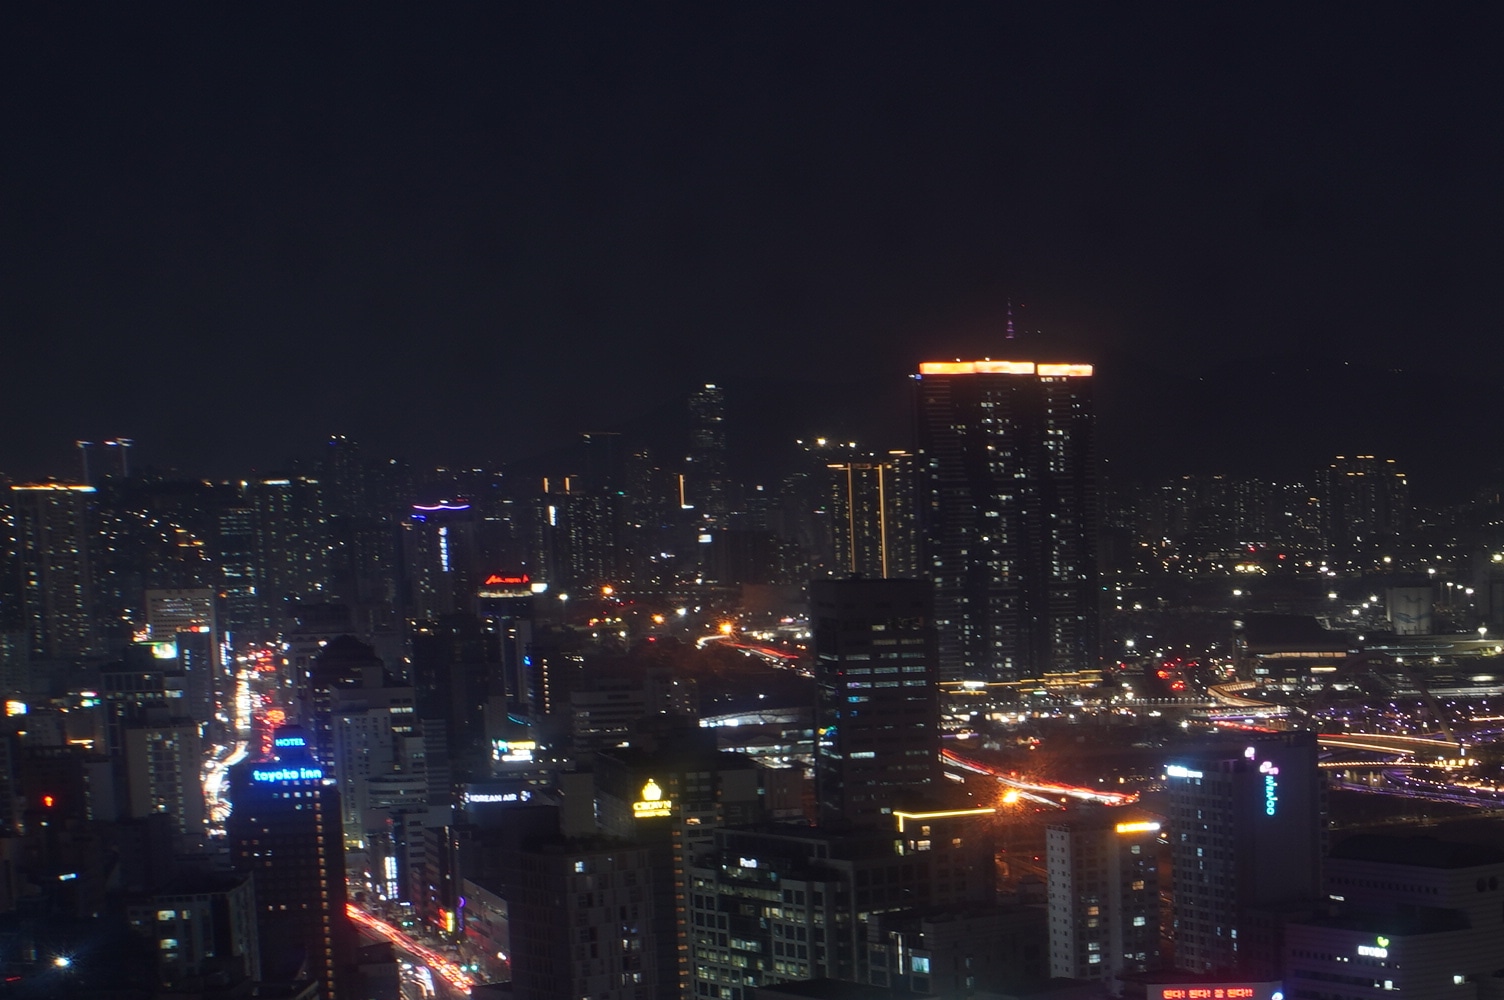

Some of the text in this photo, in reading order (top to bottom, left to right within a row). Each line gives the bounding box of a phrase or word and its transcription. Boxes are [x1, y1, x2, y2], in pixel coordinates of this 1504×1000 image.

[275, 738, 306, 747] HOTEL
[253, 767, 322, 782] toyoko inn
